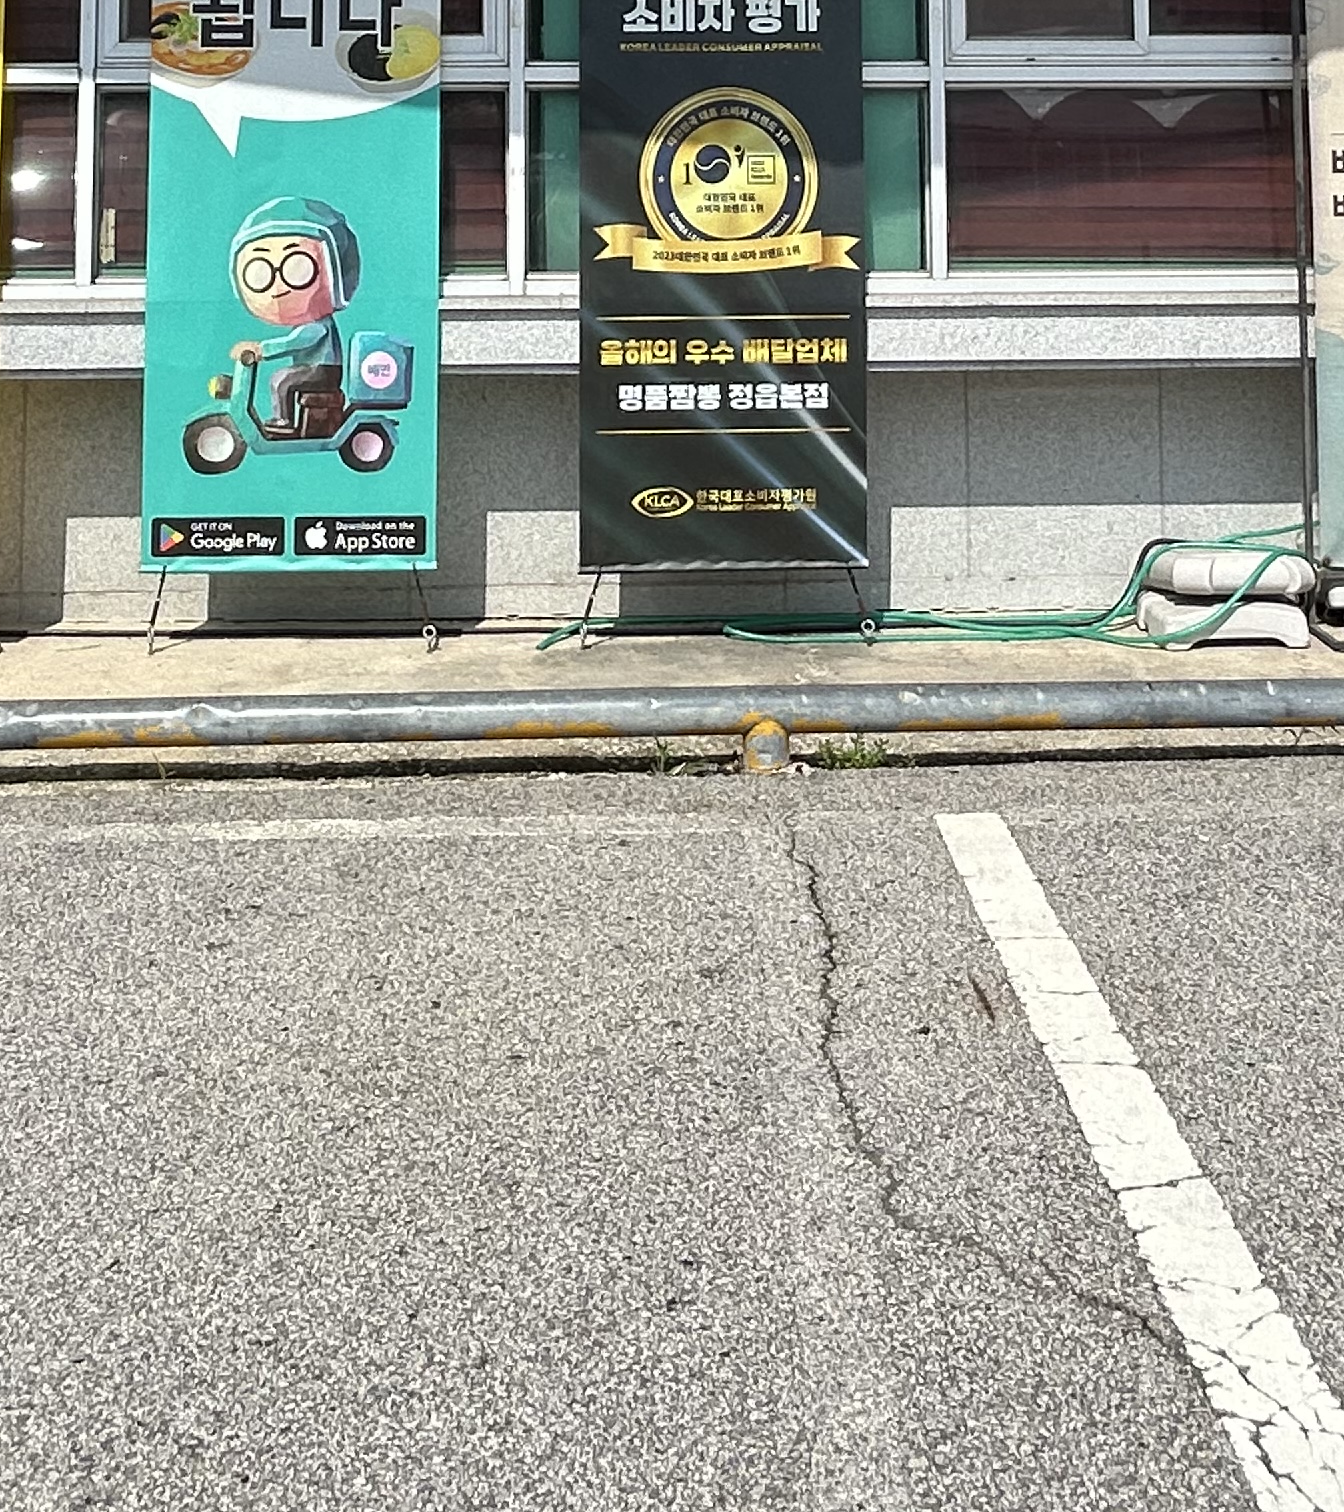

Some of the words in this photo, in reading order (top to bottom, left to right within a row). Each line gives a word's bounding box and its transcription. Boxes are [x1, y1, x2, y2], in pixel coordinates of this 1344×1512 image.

[600, 339, 677, 366] 올해의
[684, 339, 735, 365] 우수
[742, 338, 848, 364] 배달업체
[644, 494, 680, 508] KLCA
[190, 522, 208, 532] GET
[335, 521, 382, 531] Download
[190, 533, 244, 552] Google
[246, 532, 278, 552] Play
[335, 533, 371, 552] App
[371, 532, 416, 550] Store
